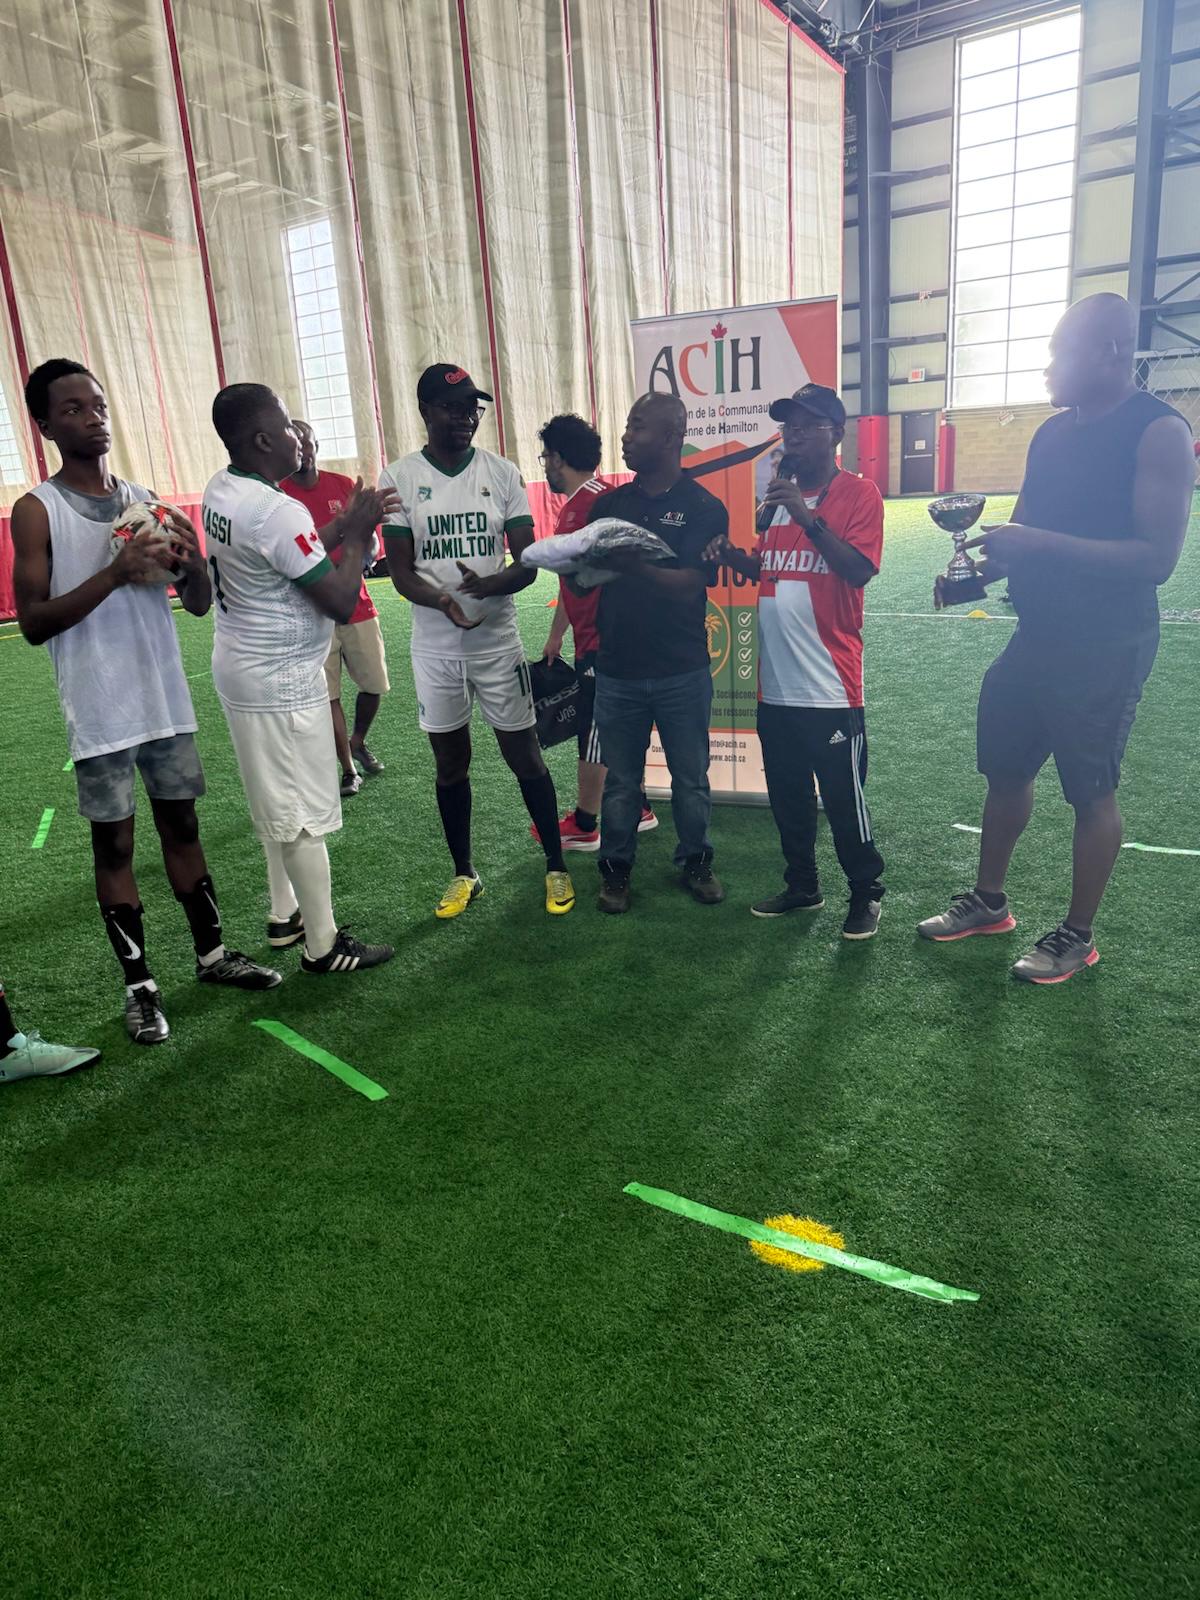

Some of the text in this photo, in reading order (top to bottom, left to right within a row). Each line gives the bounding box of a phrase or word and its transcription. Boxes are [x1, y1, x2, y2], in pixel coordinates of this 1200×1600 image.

[695, 407, 706, 419] de
[708, 406, 716, 418] la
[705, 423, 716, 435] de
[718, 420, 759, 434] Hamilton
[427, 511, 487, 537] UNITED
[422, 535, 496, 560] HAMILTON
[710, 739, 747, 749] nfo@acih.ca
